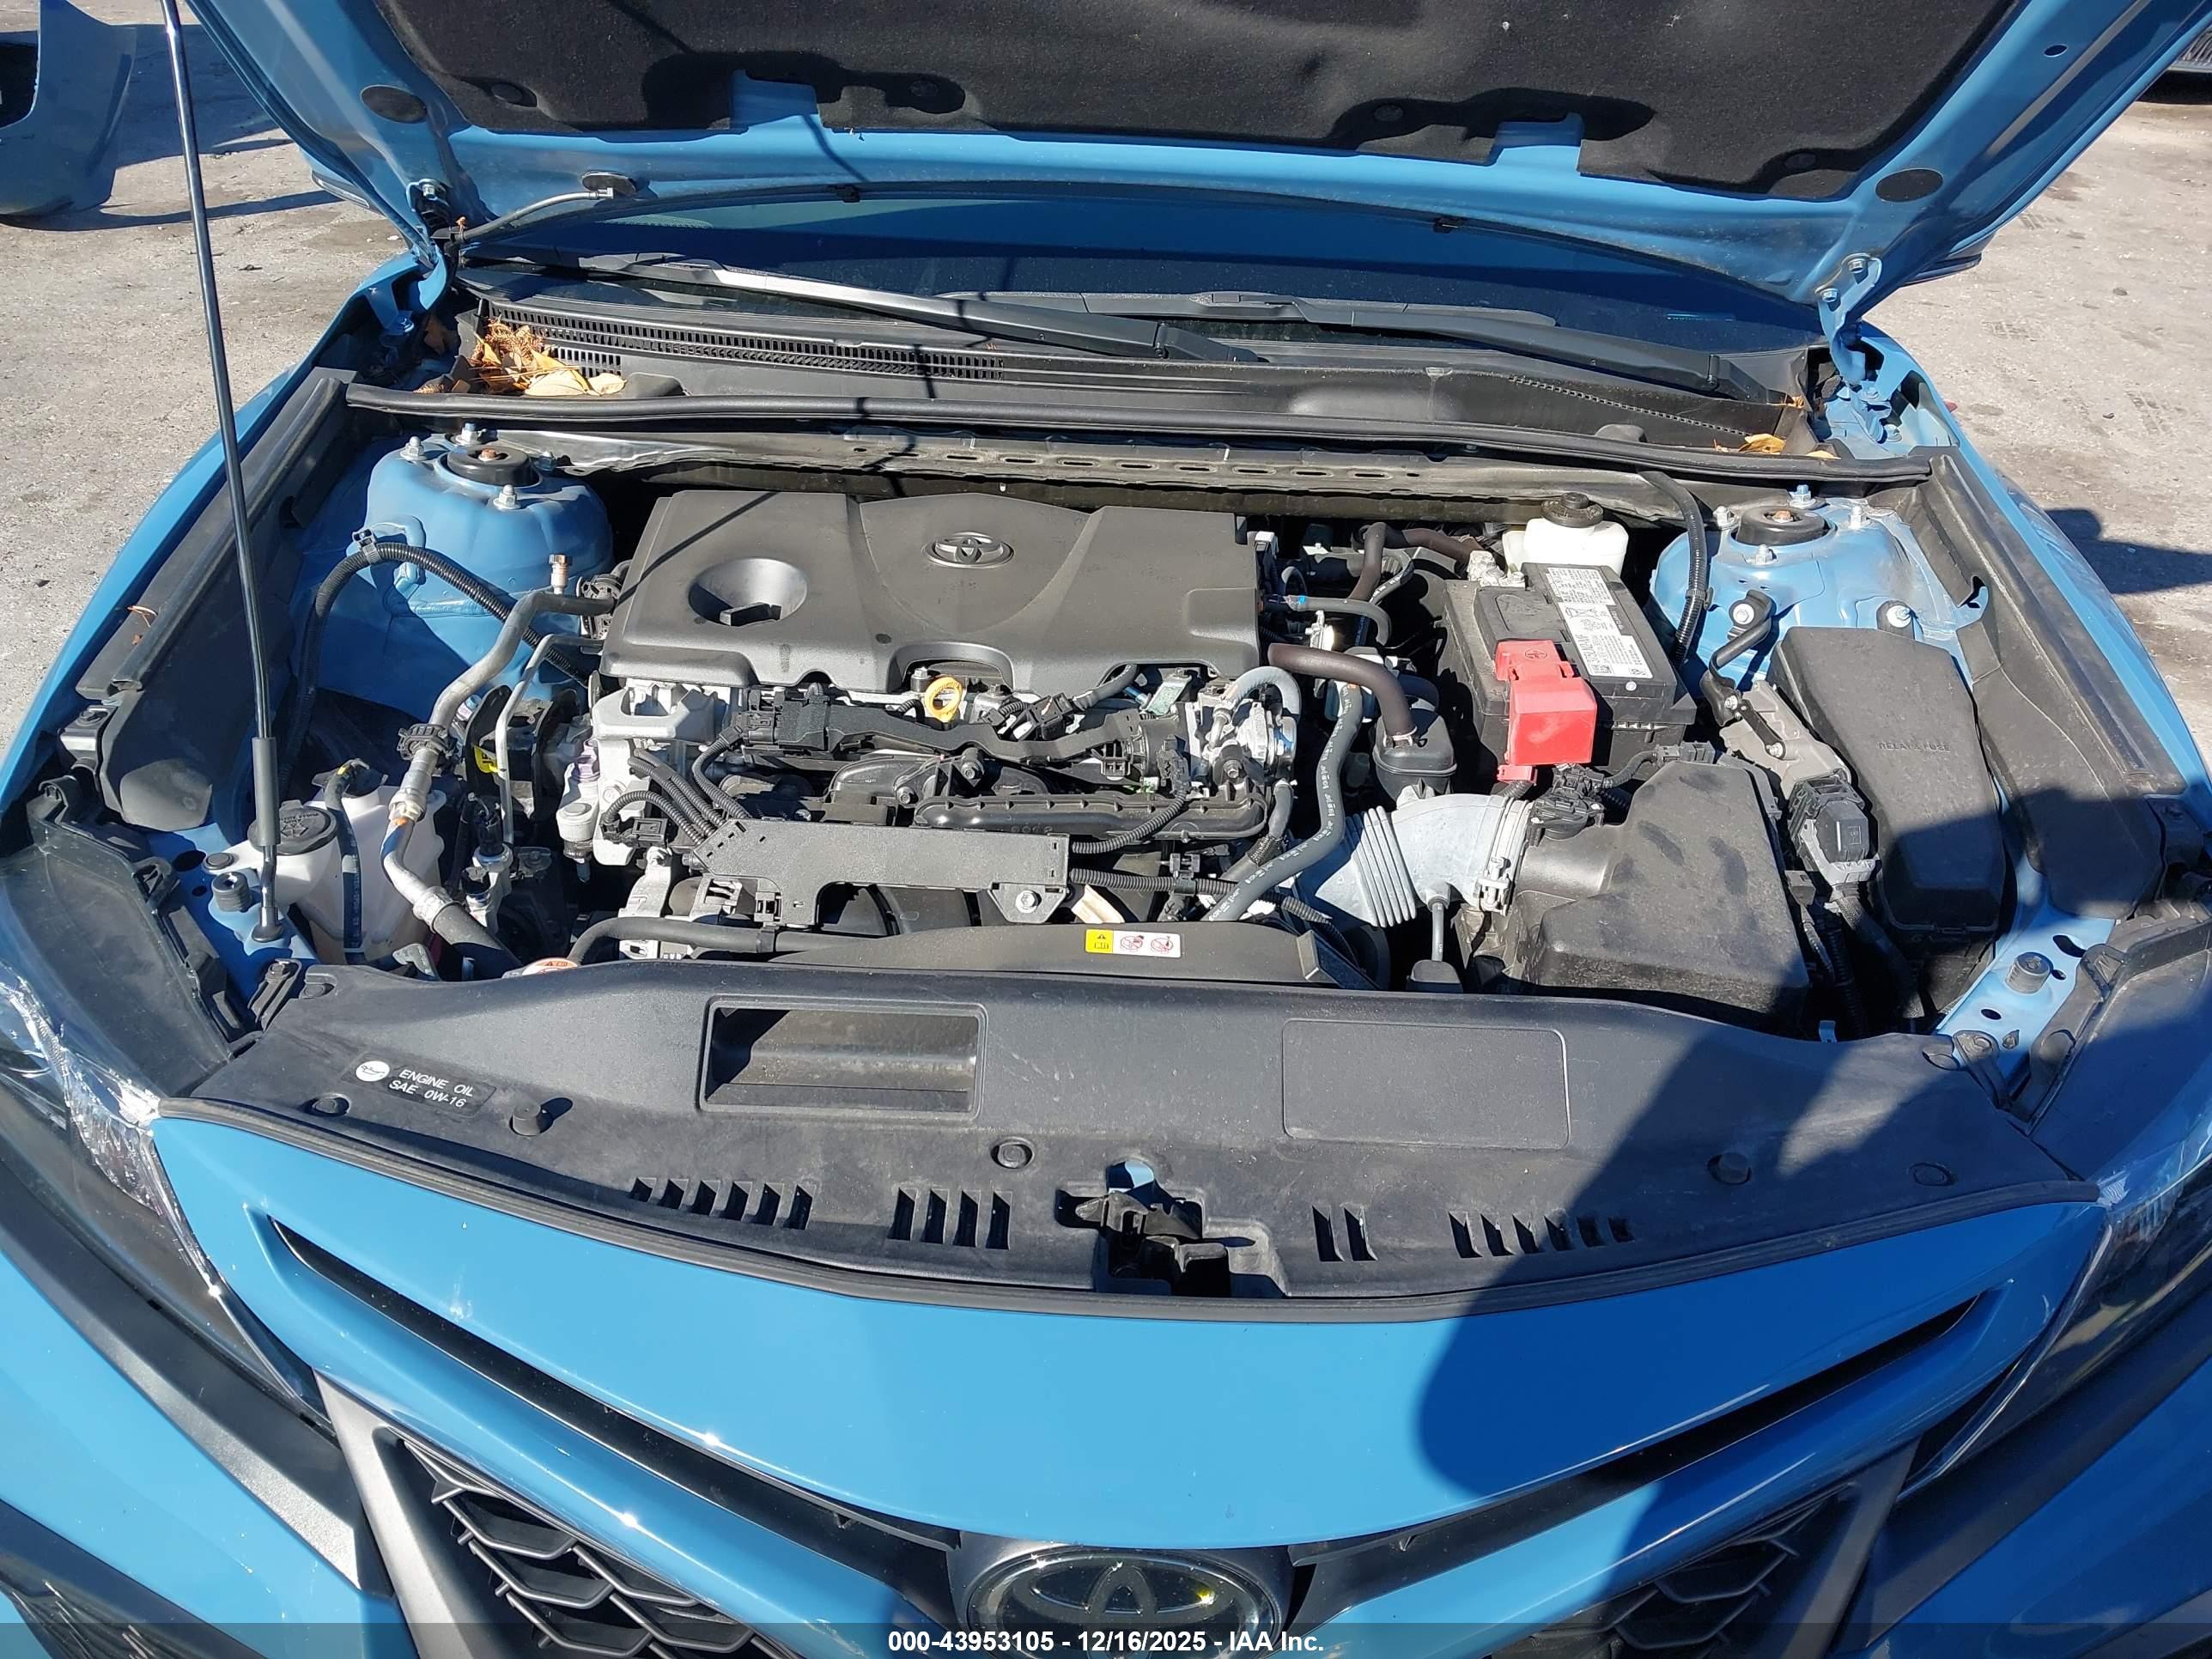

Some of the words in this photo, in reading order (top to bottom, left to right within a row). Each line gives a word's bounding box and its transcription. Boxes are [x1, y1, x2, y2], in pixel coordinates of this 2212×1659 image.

[389, 1079, 419, 1094] SAE
[423, 1090, 467, 1109] 0W-16
[398, 1069, 449, 1089] ENGINE
[453, 1084, 474, 1097] OIL
